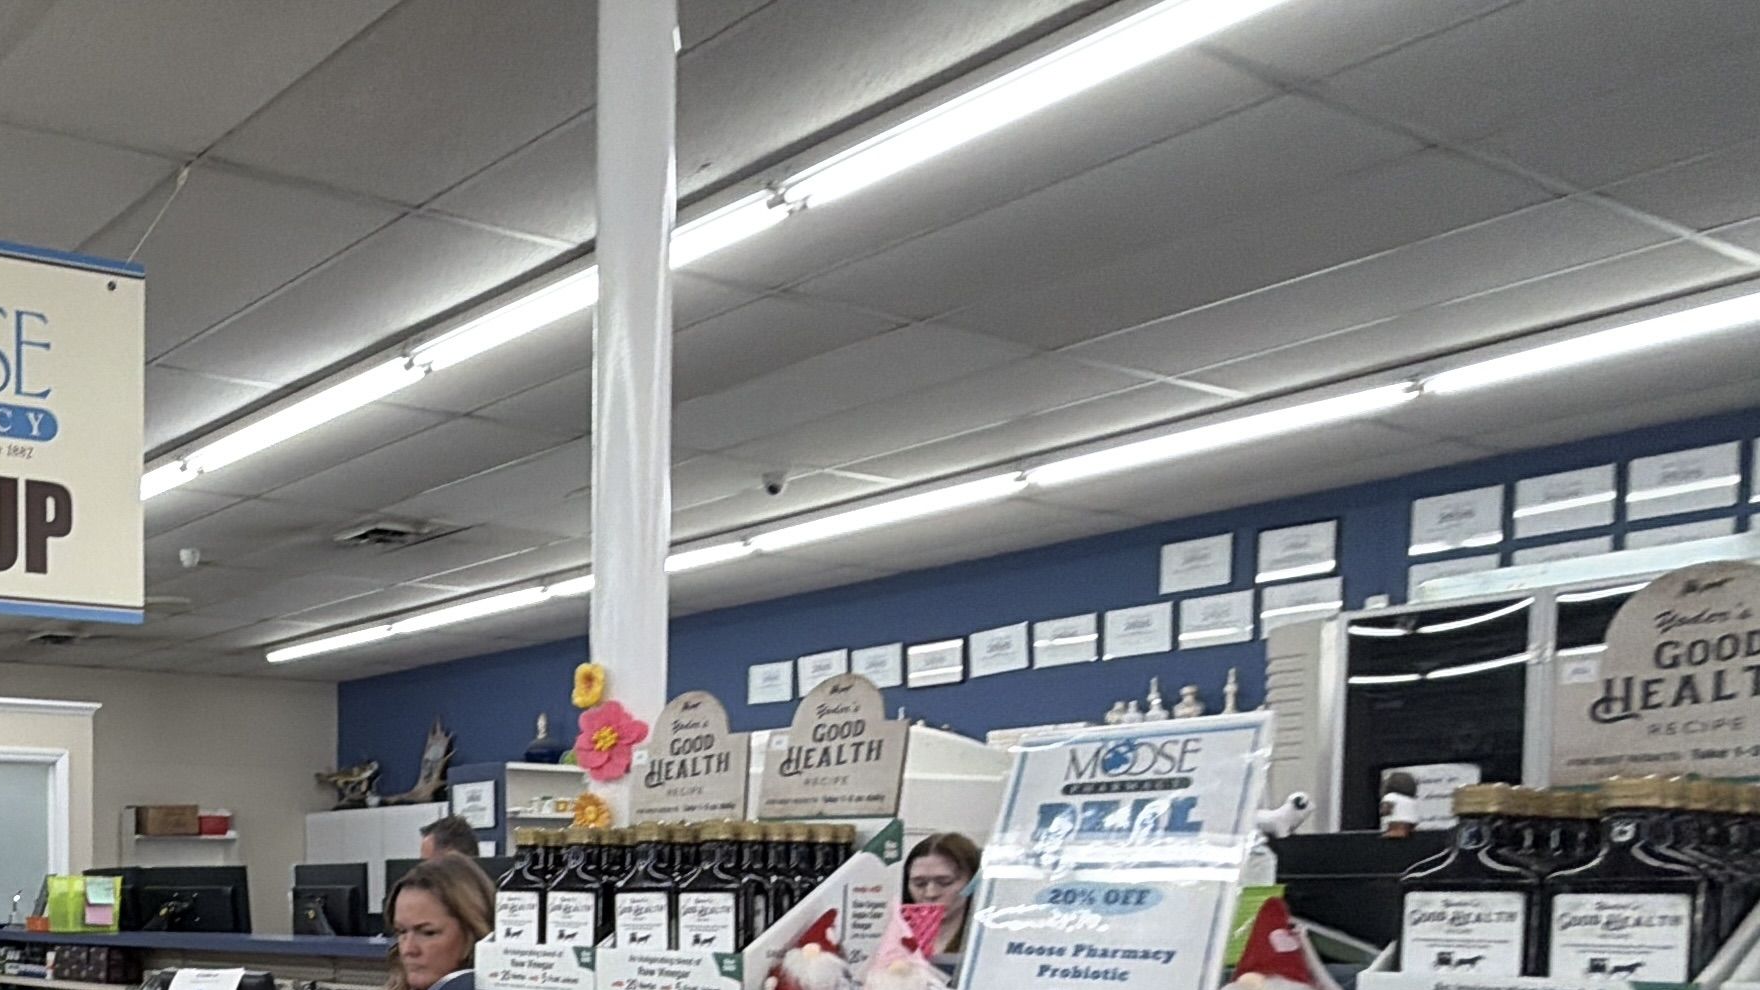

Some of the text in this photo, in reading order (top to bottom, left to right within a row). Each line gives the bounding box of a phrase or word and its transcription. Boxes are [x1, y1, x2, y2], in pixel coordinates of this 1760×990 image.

[1590, 664, 1760, 724] HEALT
[812, 719, 865, 742] GOOD
[670, 733, 715, 756] GOOD
[780, 739, 884, 777] HEALTH
[1064, 738, 1203, 782] MOOSE
[645, 752, 730, 788] HEALTH
[1049, 887, 1154, 906] 20% OFF
[1006, 941, 1177, 964] Moose Pharmacy
[1036, 964, 1132, 982] Probiotic
